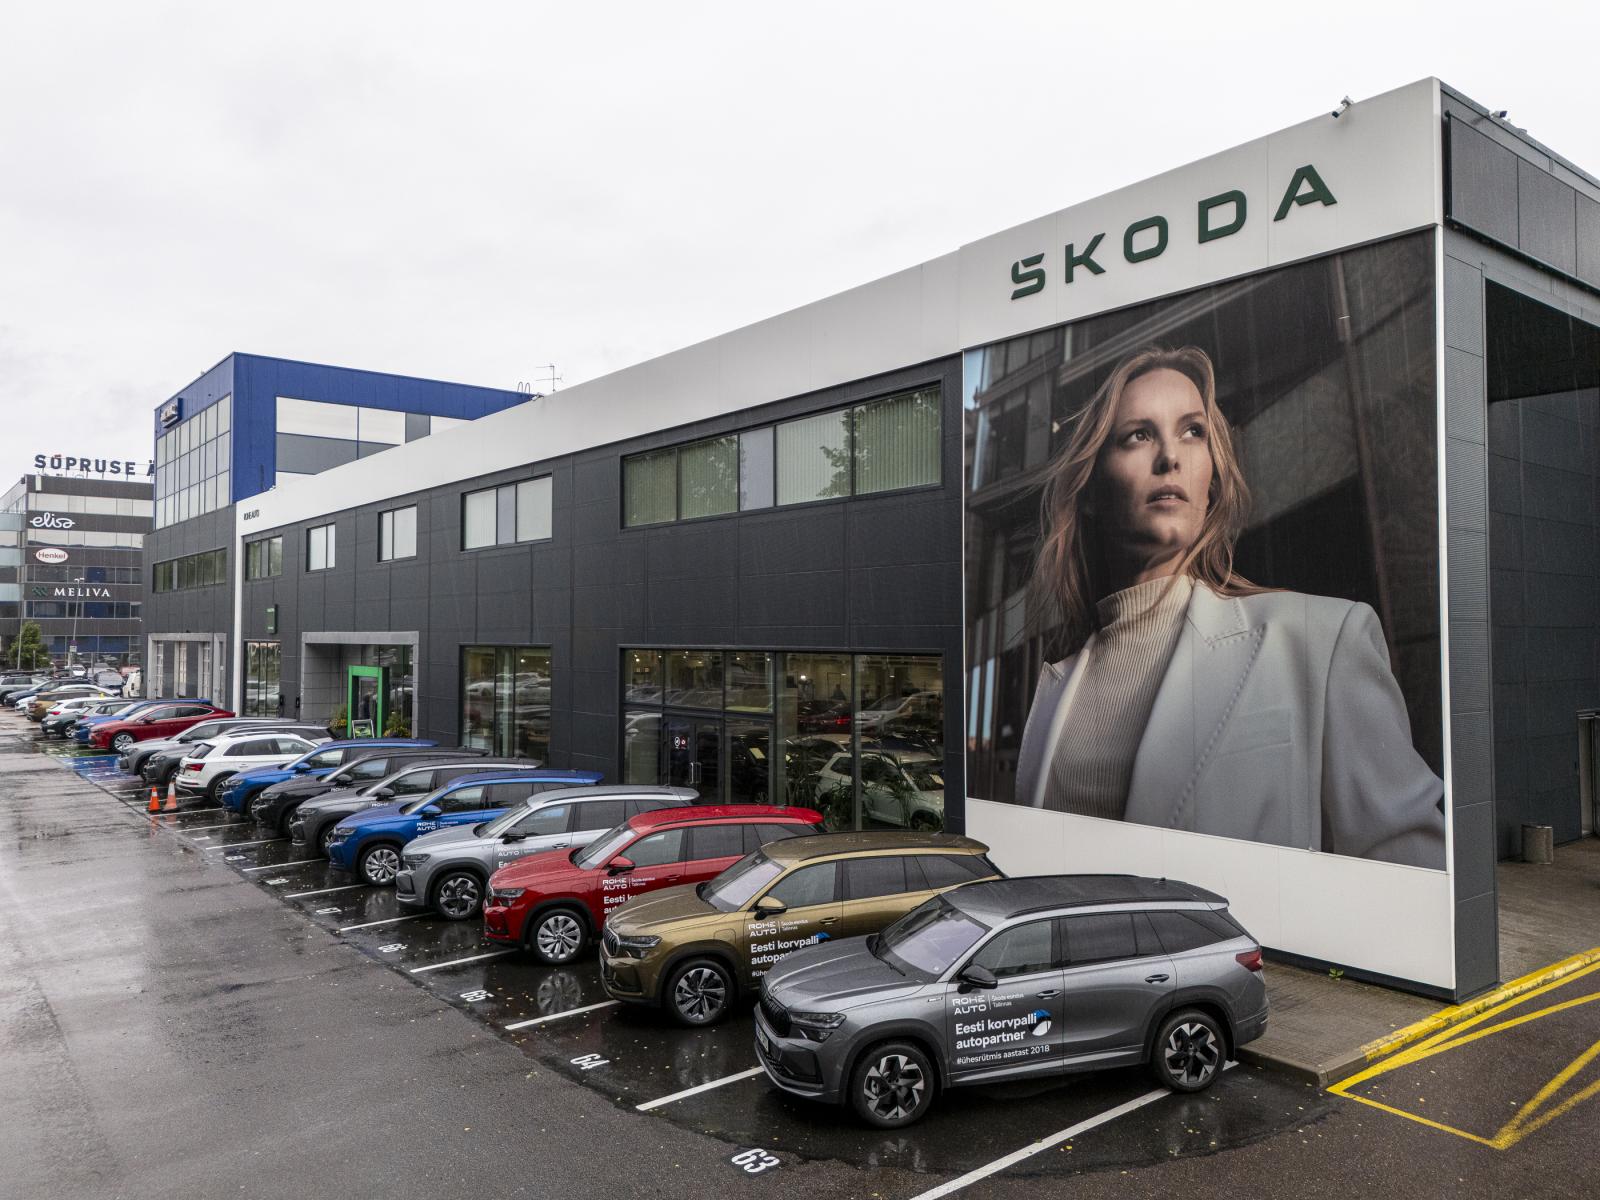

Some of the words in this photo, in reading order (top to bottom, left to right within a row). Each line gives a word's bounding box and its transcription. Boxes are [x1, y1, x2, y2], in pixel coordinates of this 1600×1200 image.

[1011, 164, 1337, 300] SKODA
[30, 512, 75, 529] elisa
[38, 552, 66, 560] Henkel
[54, 587, 111, 598] MELIVA
[603, 883, 628, 891] AUTO
[603, 894, 625, 905] Eesti
[749, 928, 777, 937] AUTO
[750, 941, 775, 953] Eesti
[777, 935, 819, 949] korvpalli
[952, 995, 986, 1006] ROHE
[954, 1004, 987, 1015] AUTO
[955, 1021, 985, 1035] Eesti
[987, 1013, 1037, 1029] korvpalli
[956, 1031, 1026, 1049] autopartner
[570, 1053, 610, 1070] 64
[957, 1051, 1002, 1065] #ühesrütmis
[1003, 1049, 1029, 1058] aastast
[1031, 1044, 1050, 1054] 2018
[731, 1148, 780, 1173] 63
